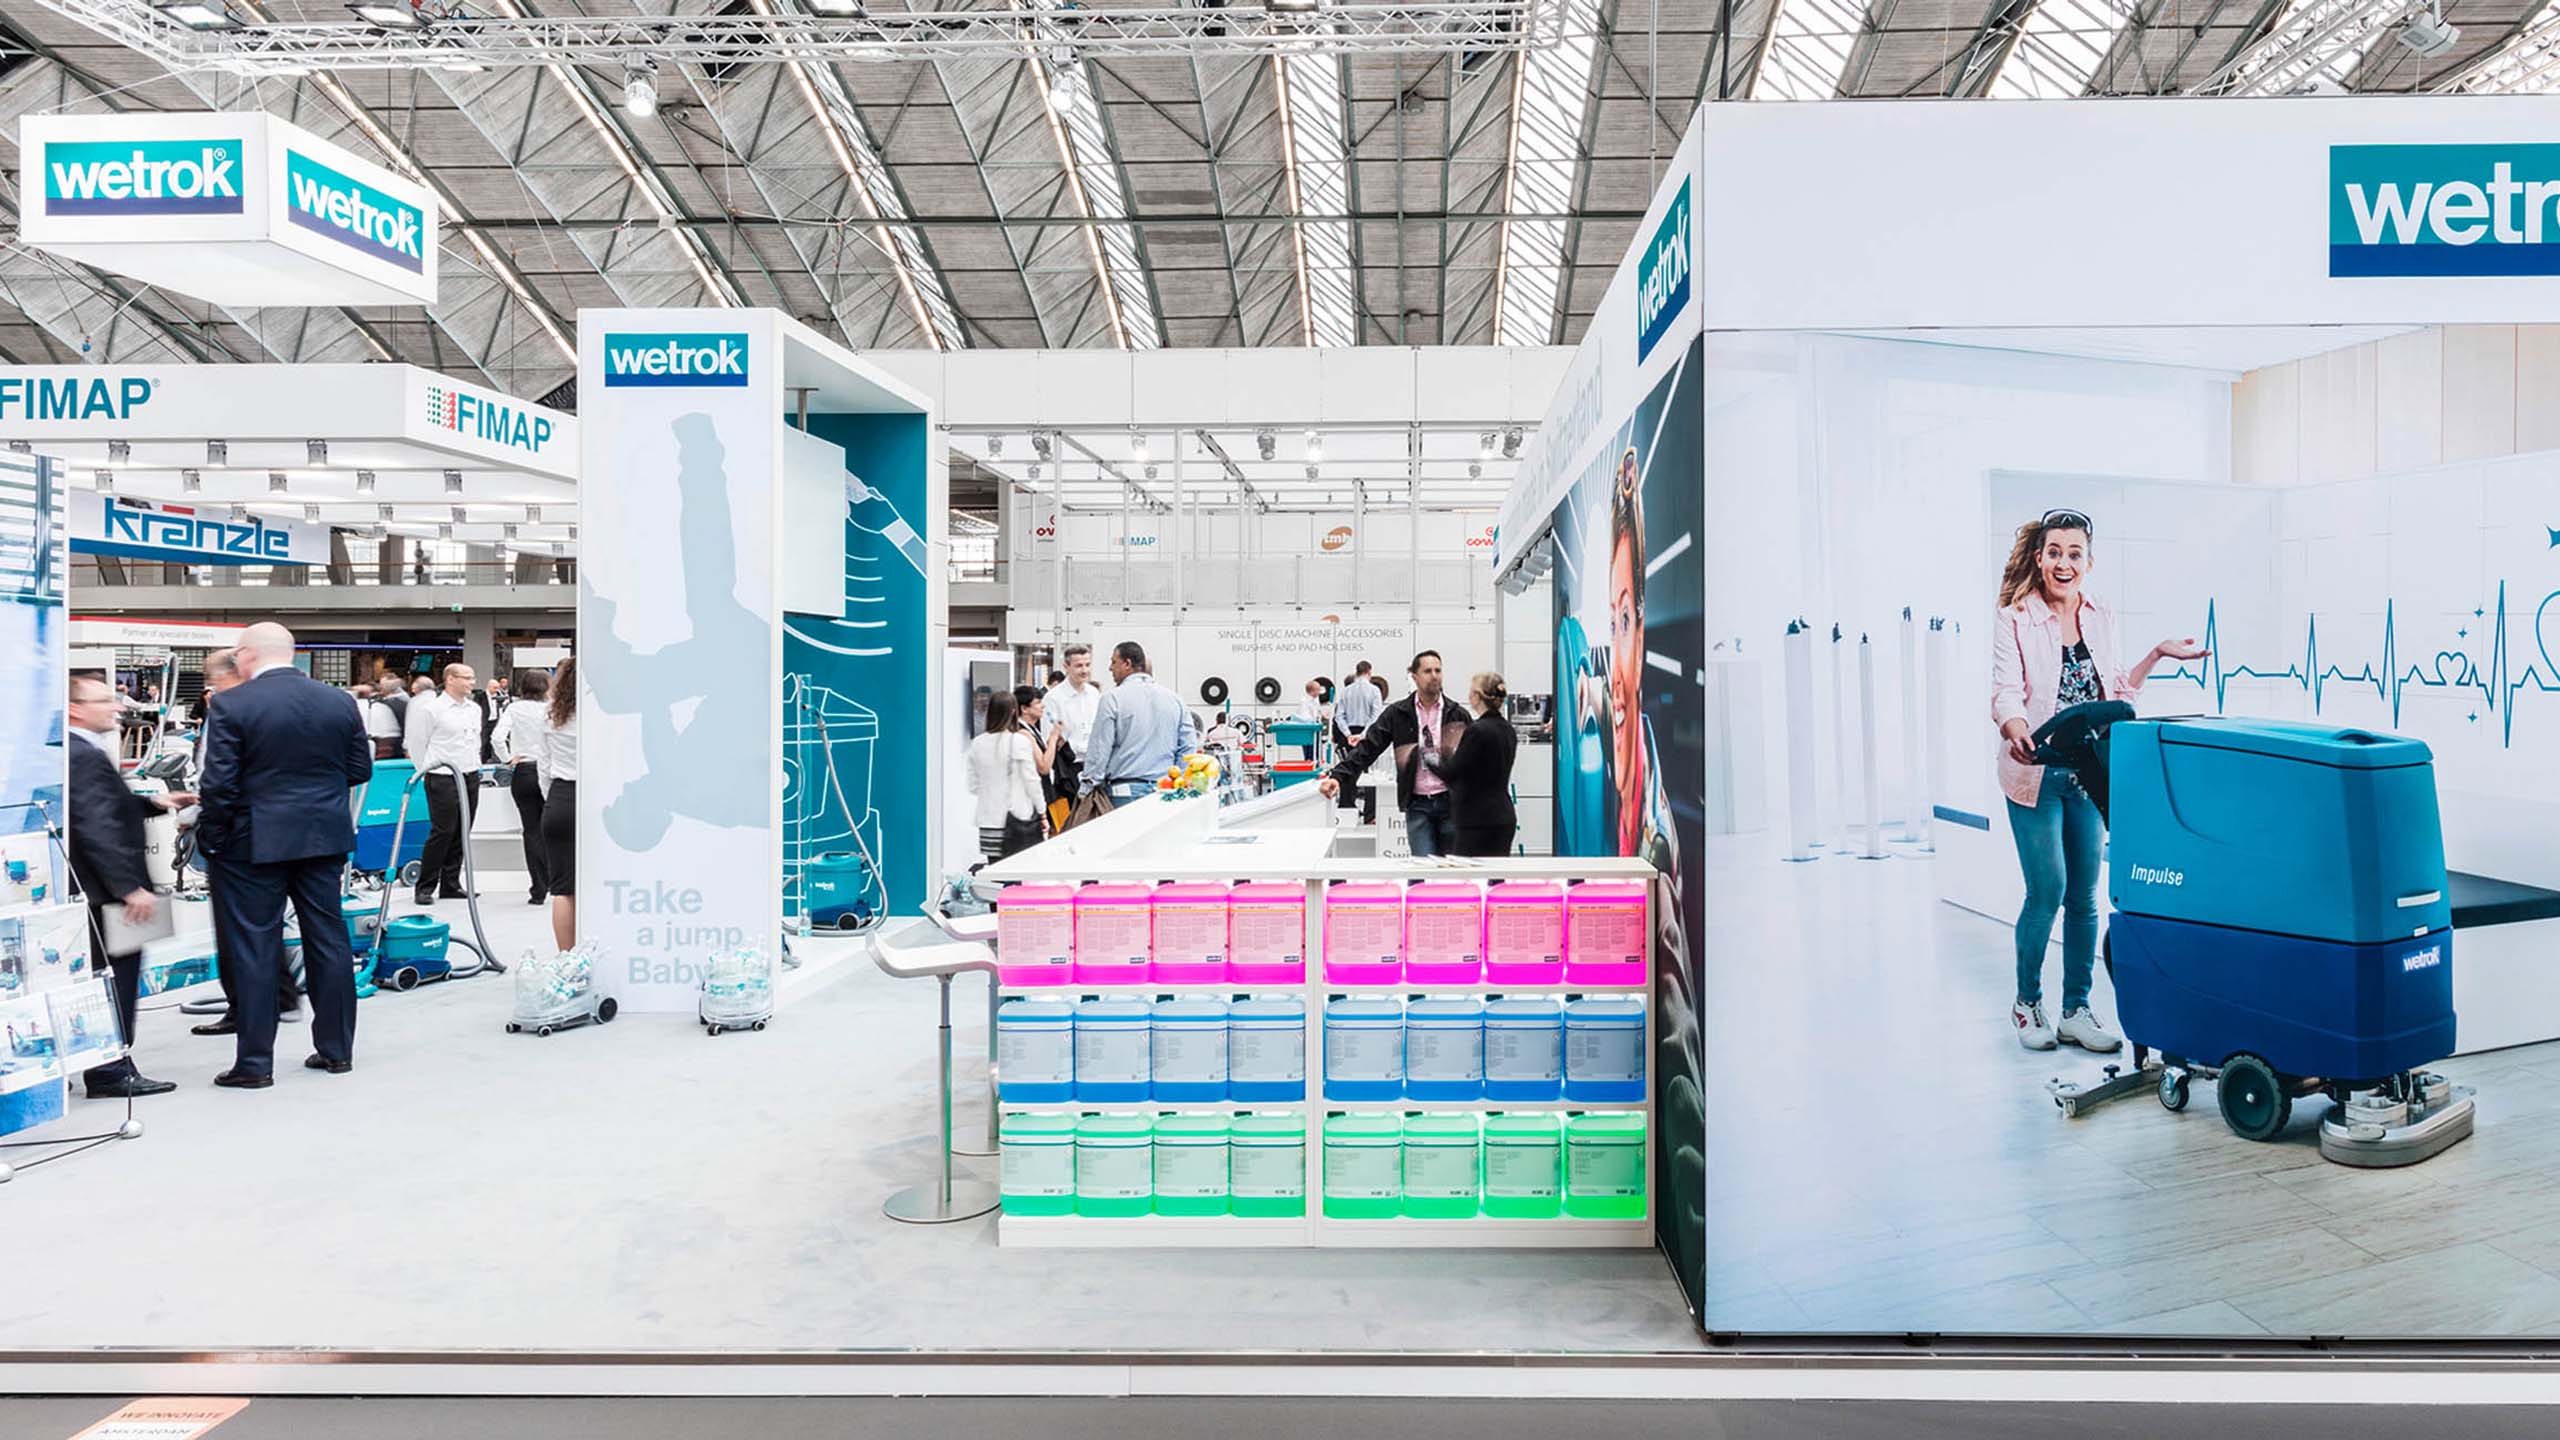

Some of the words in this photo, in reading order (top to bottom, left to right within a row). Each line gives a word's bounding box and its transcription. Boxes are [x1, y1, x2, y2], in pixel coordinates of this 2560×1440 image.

[2344, 161, 2560, 246] wetr
[1218, 629, 1252, 639] SINGLE
[1258, 629, 1282, 639] DISC
[1284, 628, 1332, 639] MACHINE
[1338, 628, 1404, 639] ACCESSORIES
[1231, 643, 1273, 652] BRUSHES
[1276, 643, 1297, 652] AND
[1299, 643, 1318, 652] PAD
[2131, 863, 2184, 887] Impulse
[603, 880, 703, 915] Take
[637, 926, 654, 947] a
[664, 921, 744, 951] jump
